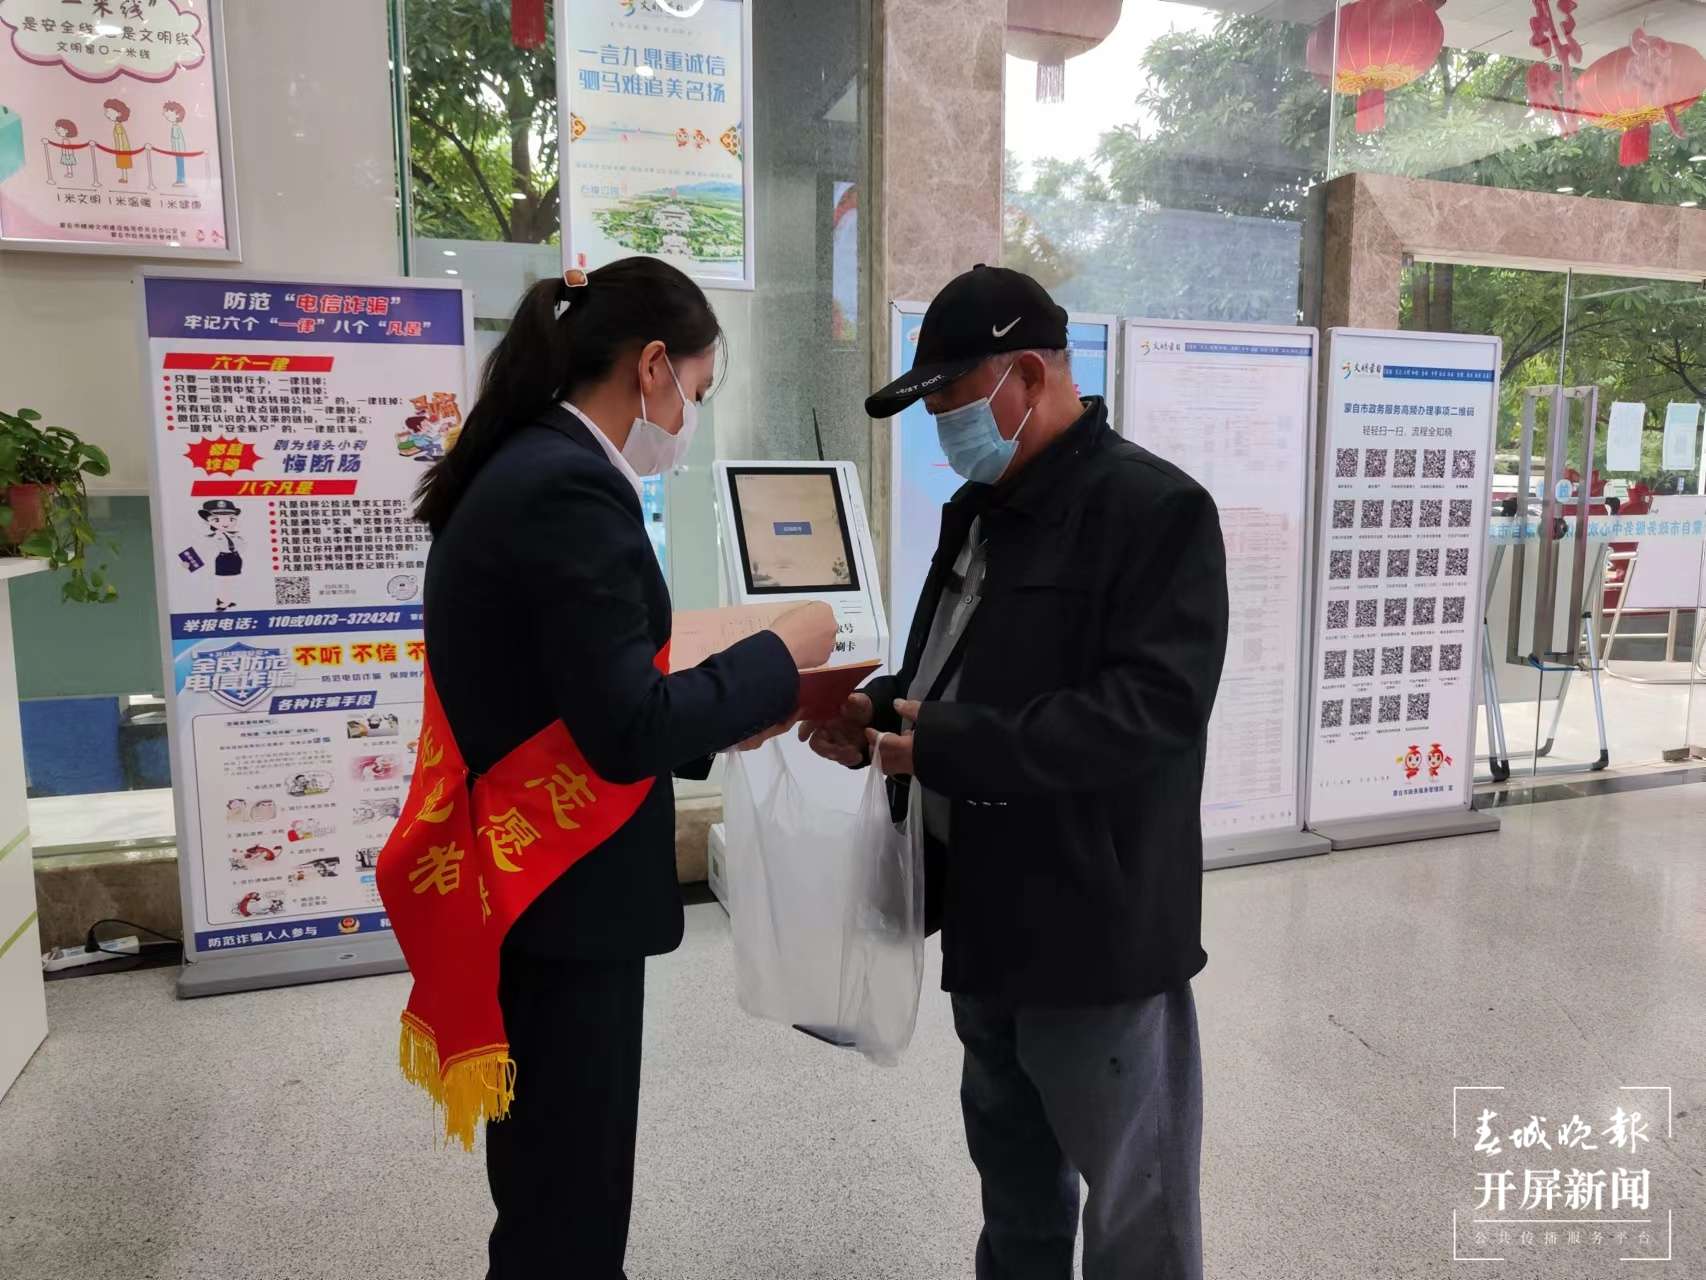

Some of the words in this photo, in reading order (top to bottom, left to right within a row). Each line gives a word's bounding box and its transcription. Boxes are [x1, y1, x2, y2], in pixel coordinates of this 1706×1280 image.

[578, 43, 726, 77] 一言九鼎重诚信
[211, 357, 290, 372] 六个一律
[282, 453, 363, 474] 悔断肠
[237, 481, 314, 496] 八个凡是
[295, 646, 342, 666] 不听
[351, 643, 397, 663] 不信
[831, 640, 857, 653] 刷卡
[277, 694, 372, 711] 各种诈骗手段
[207, 925, 318, 948] 防范诈骗人人参与
